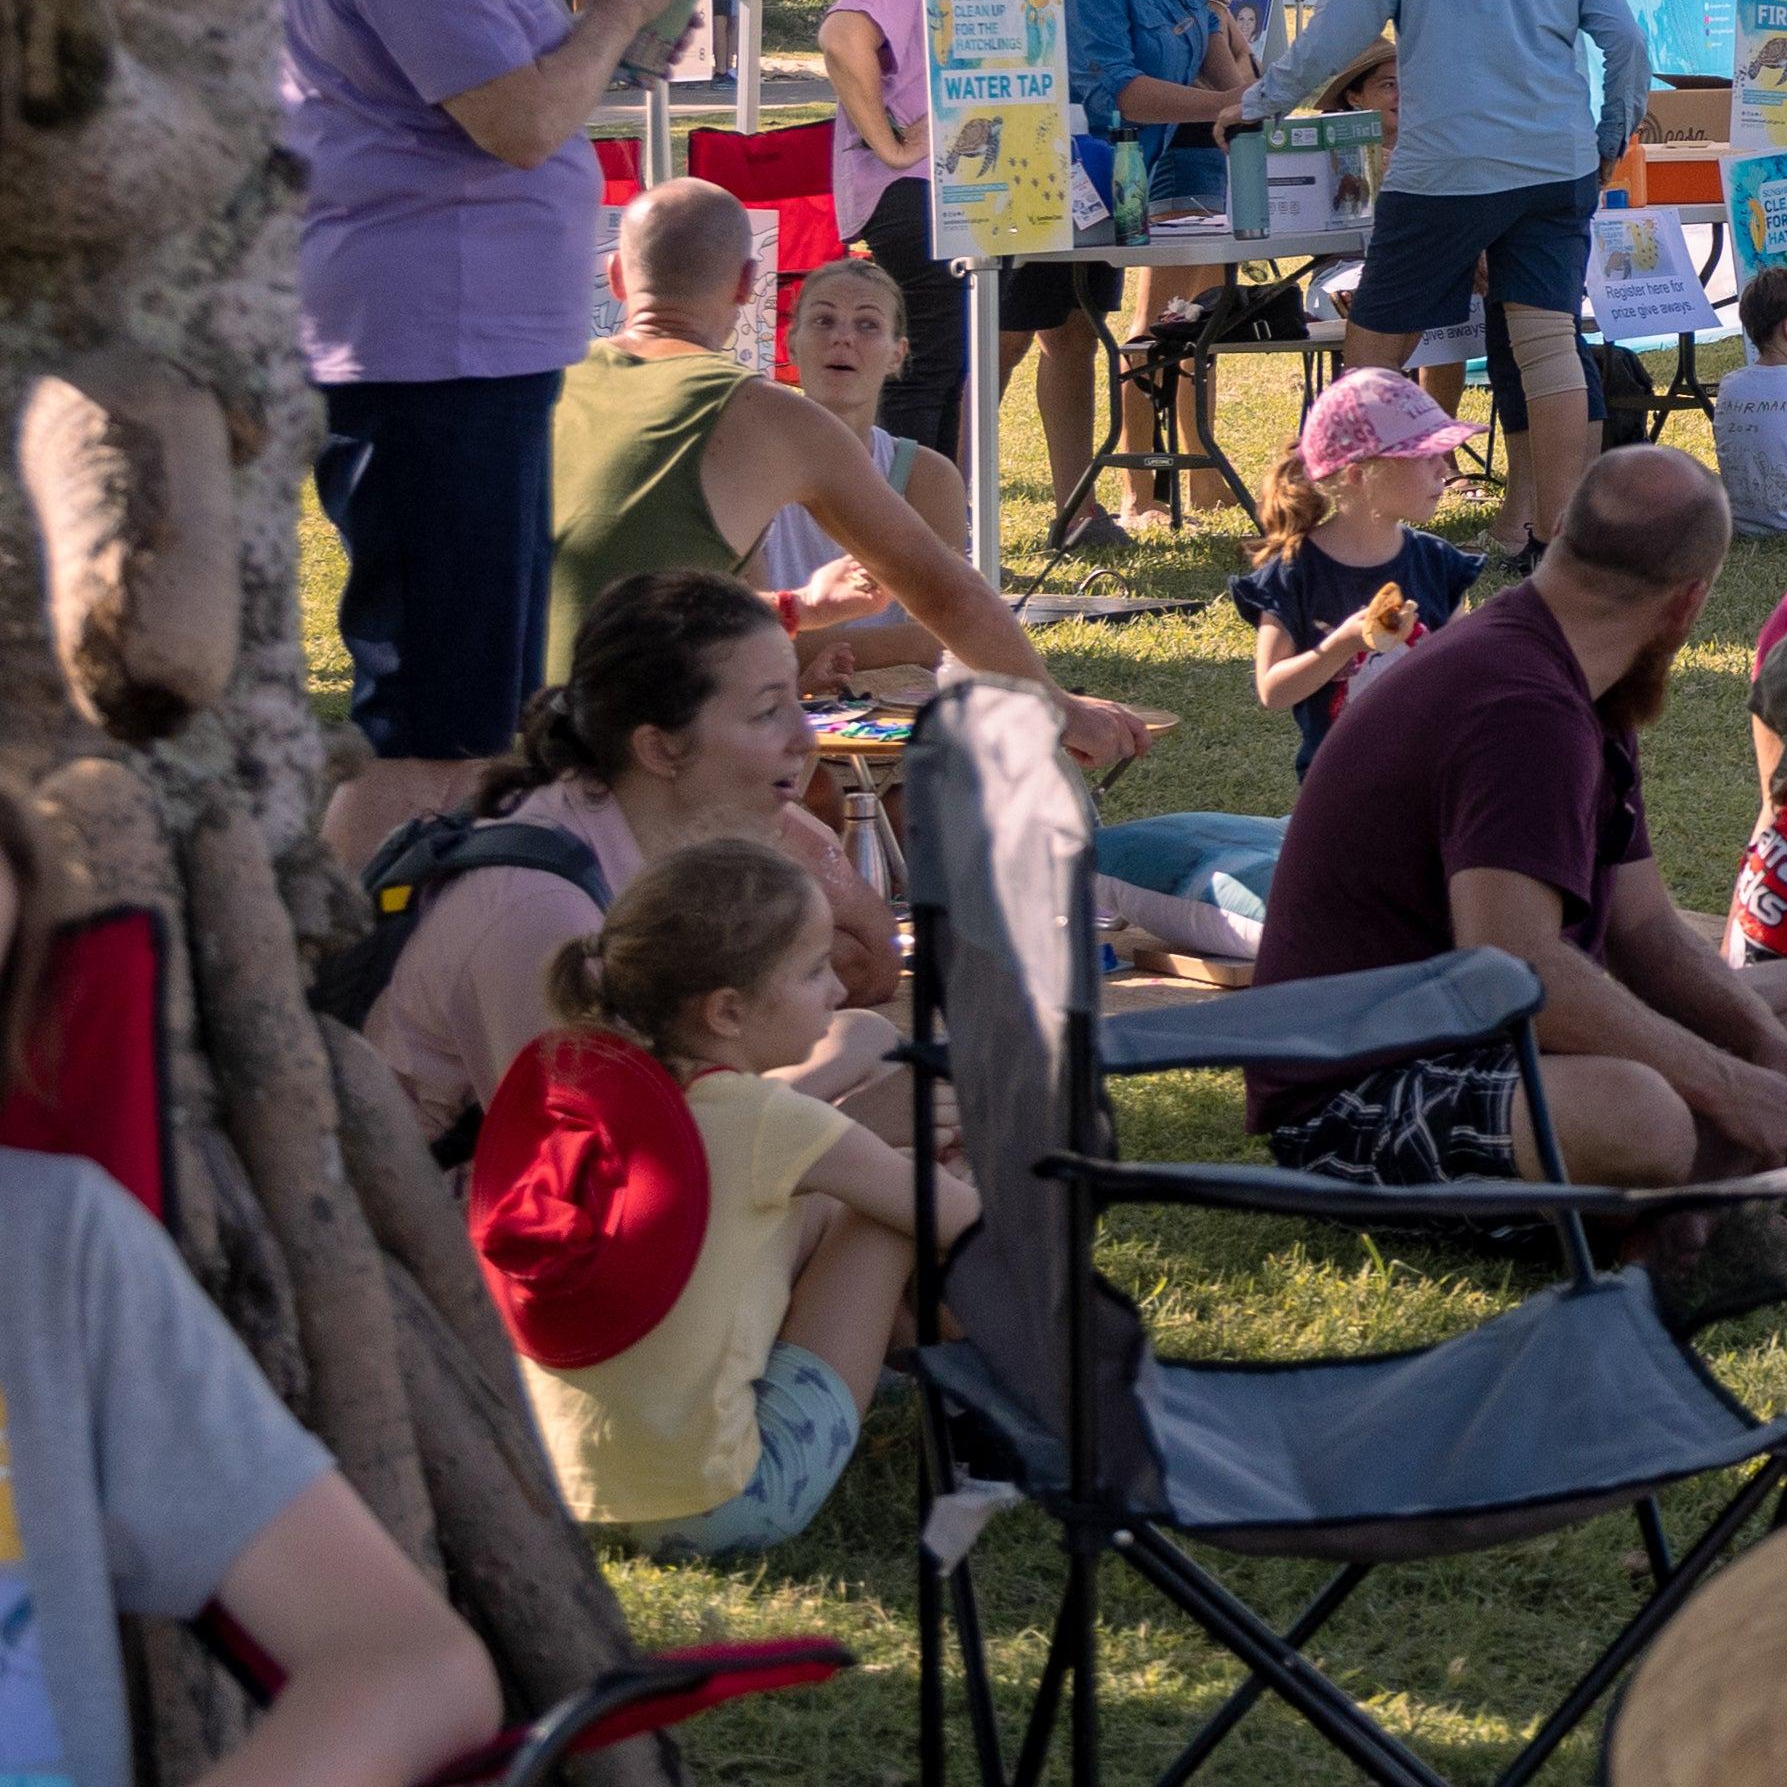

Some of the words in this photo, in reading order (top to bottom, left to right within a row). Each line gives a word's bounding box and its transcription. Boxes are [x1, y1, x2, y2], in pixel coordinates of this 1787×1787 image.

[954, 4, 991, 18] CLEAN
[991, 4, 1006, 16] UP
[954, 23, 976, 36] FOR
[977, 22, 999, 35] THE
[944, 75, 1013, 100] WATER
[1016, 73, 1053, 98] TAP
[1605, 283, 1646, 301] Register
[1646, 282, 1670, 296] here
[1670, 280, 1685, 292] for
[1610, 306, 1637, 321] prize
[1637, 304, 1660, 319] give
[1659, 300, 1696, 317] aways.
